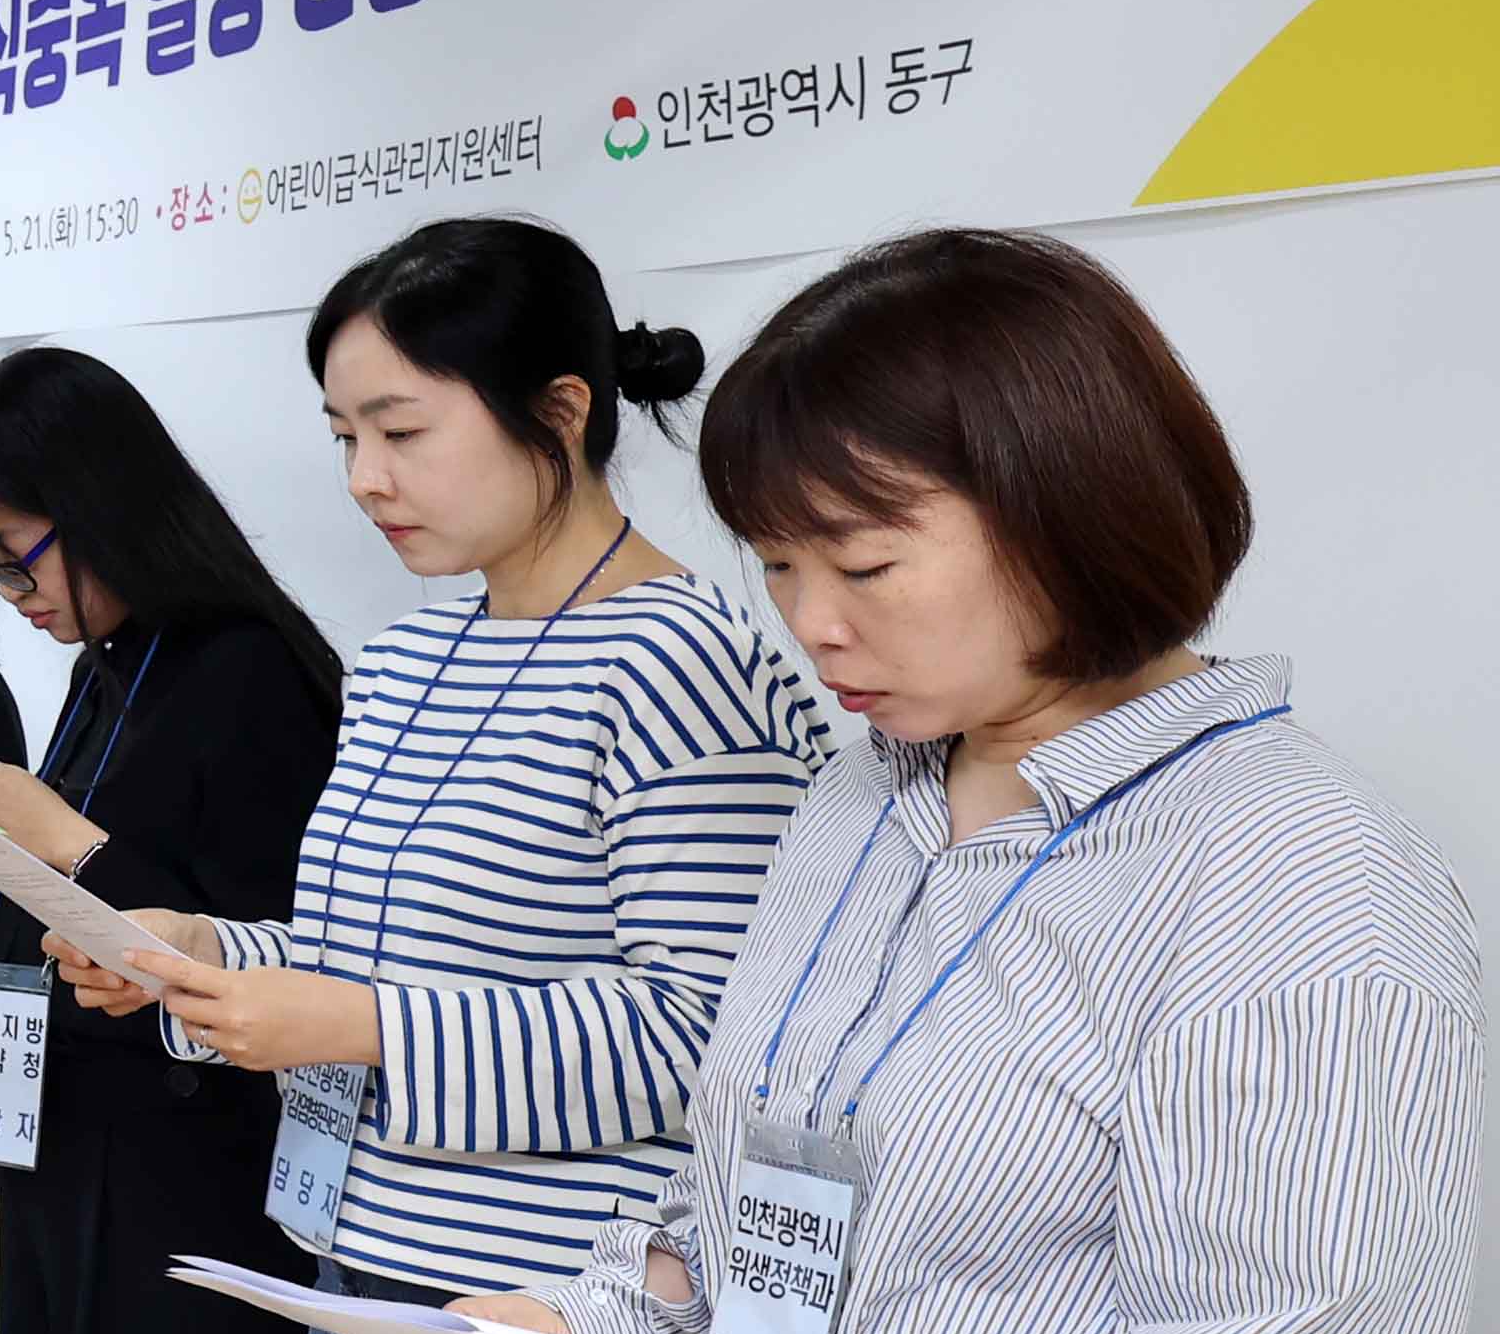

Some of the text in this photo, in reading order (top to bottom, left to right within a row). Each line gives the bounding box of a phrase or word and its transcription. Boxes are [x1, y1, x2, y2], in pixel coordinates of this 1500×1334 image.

[657, 38, 974, 149] 인천광역시 동구
[85, 196, 139, 241] 15:30
[266, 114, 543, 214] 어린이급식관리지원센터
[286, 1088, 352, 1147] 감염병관리과
[737, 1194, 844, 1260] 인천광역시
[728, 1246, 834, 1314] 위생정책과
